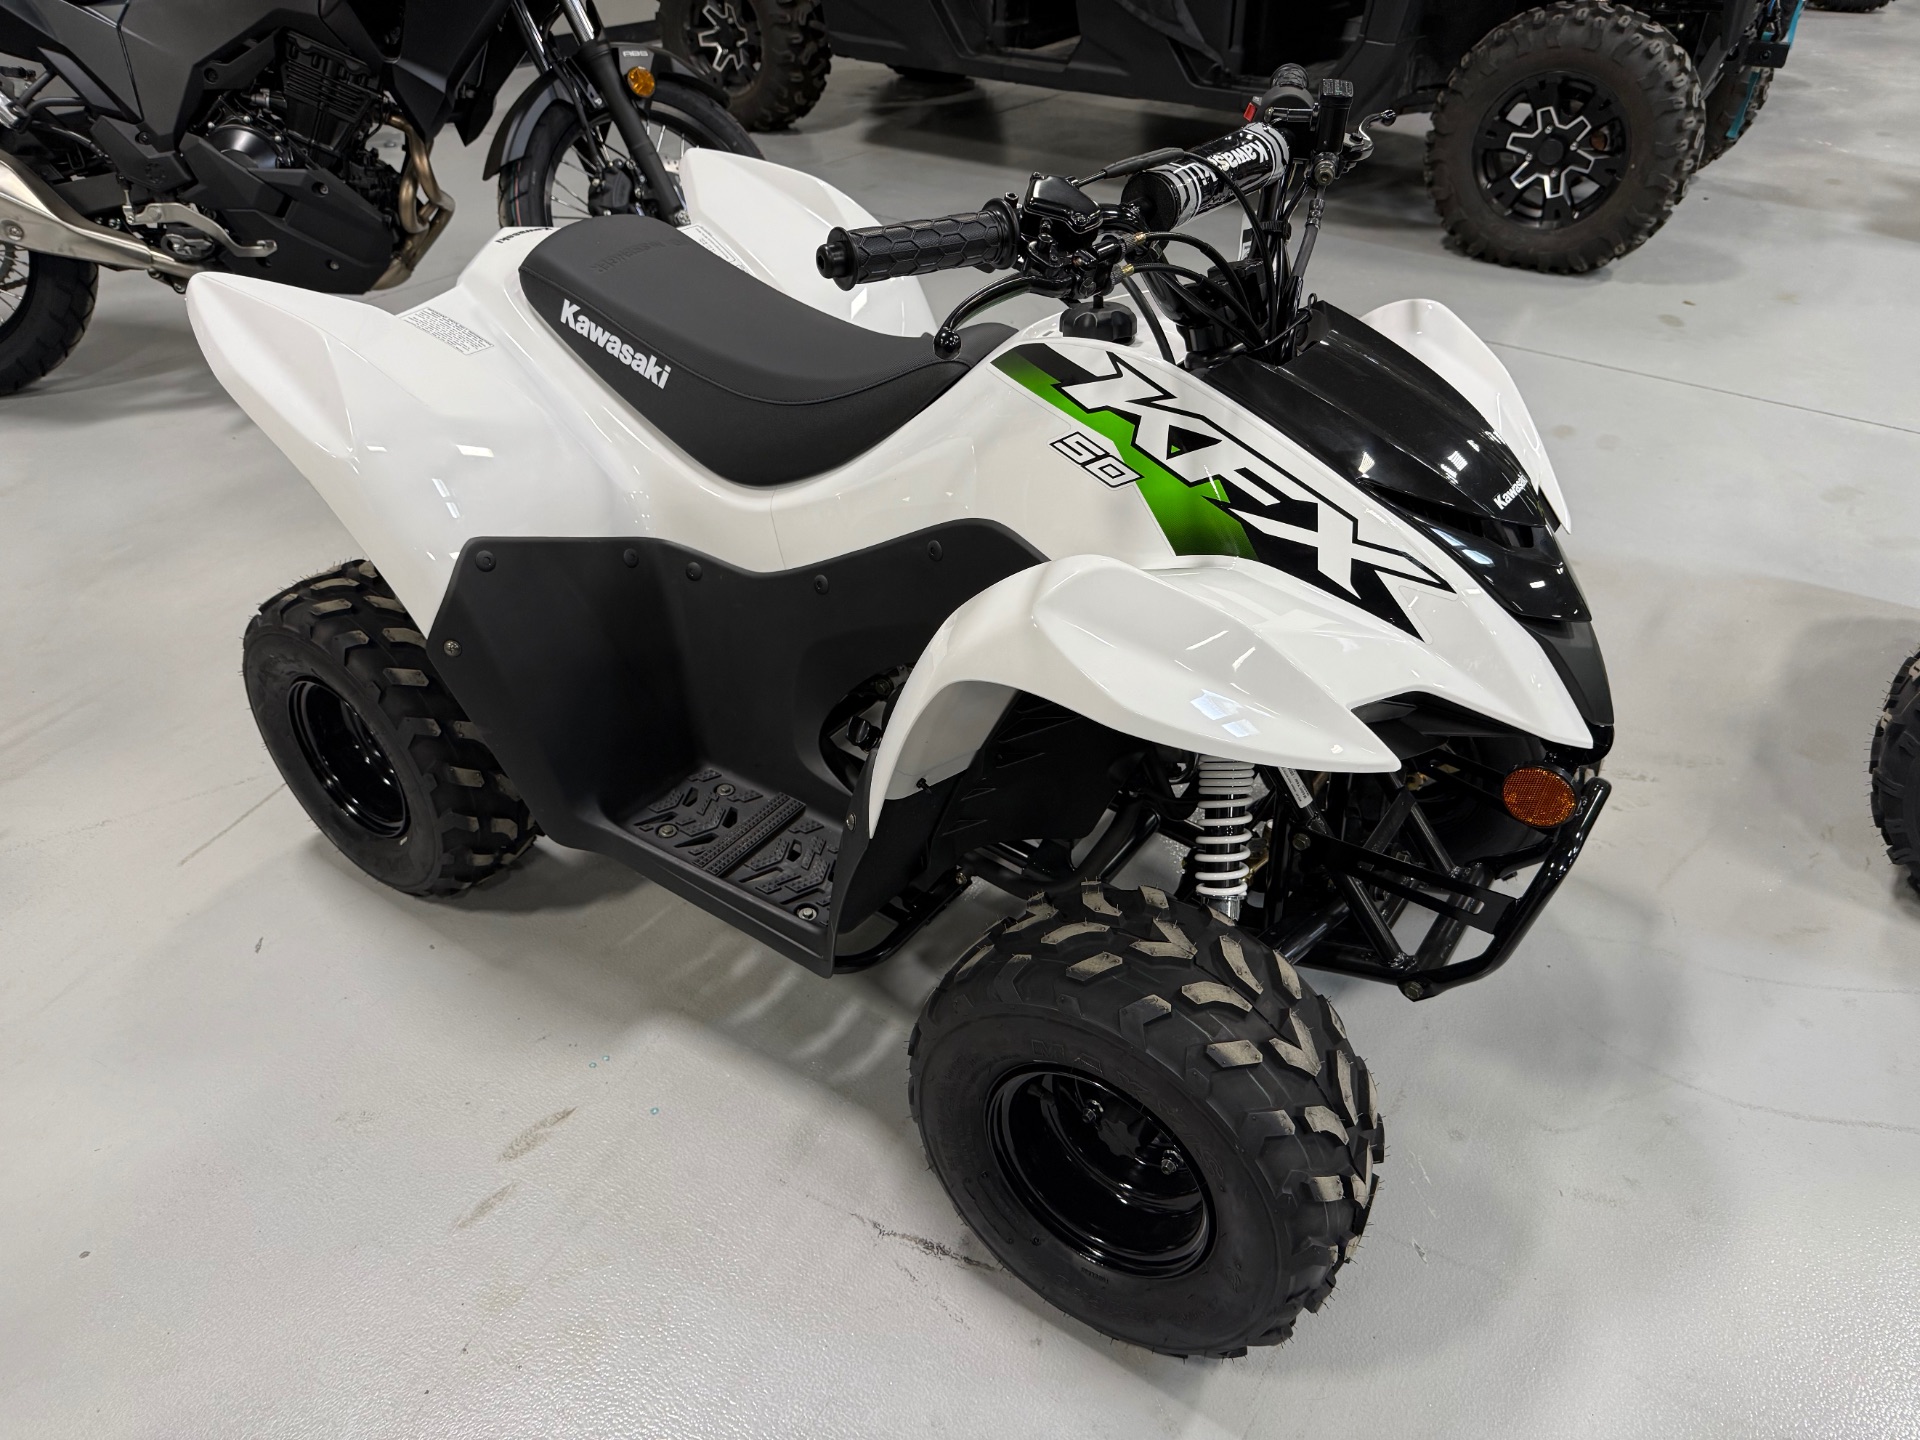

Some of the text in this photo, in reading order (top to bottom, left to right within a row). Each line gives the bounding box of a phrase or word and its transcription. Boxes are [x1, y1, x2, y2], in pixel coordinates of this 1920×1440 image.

[560, 298, 672, 390] Kawasaki
[1048, 431, 1145, 489] 50
[1051, 350, 1457, 602] KFX
[1493, 471, 1529, 511] Kawasaki
